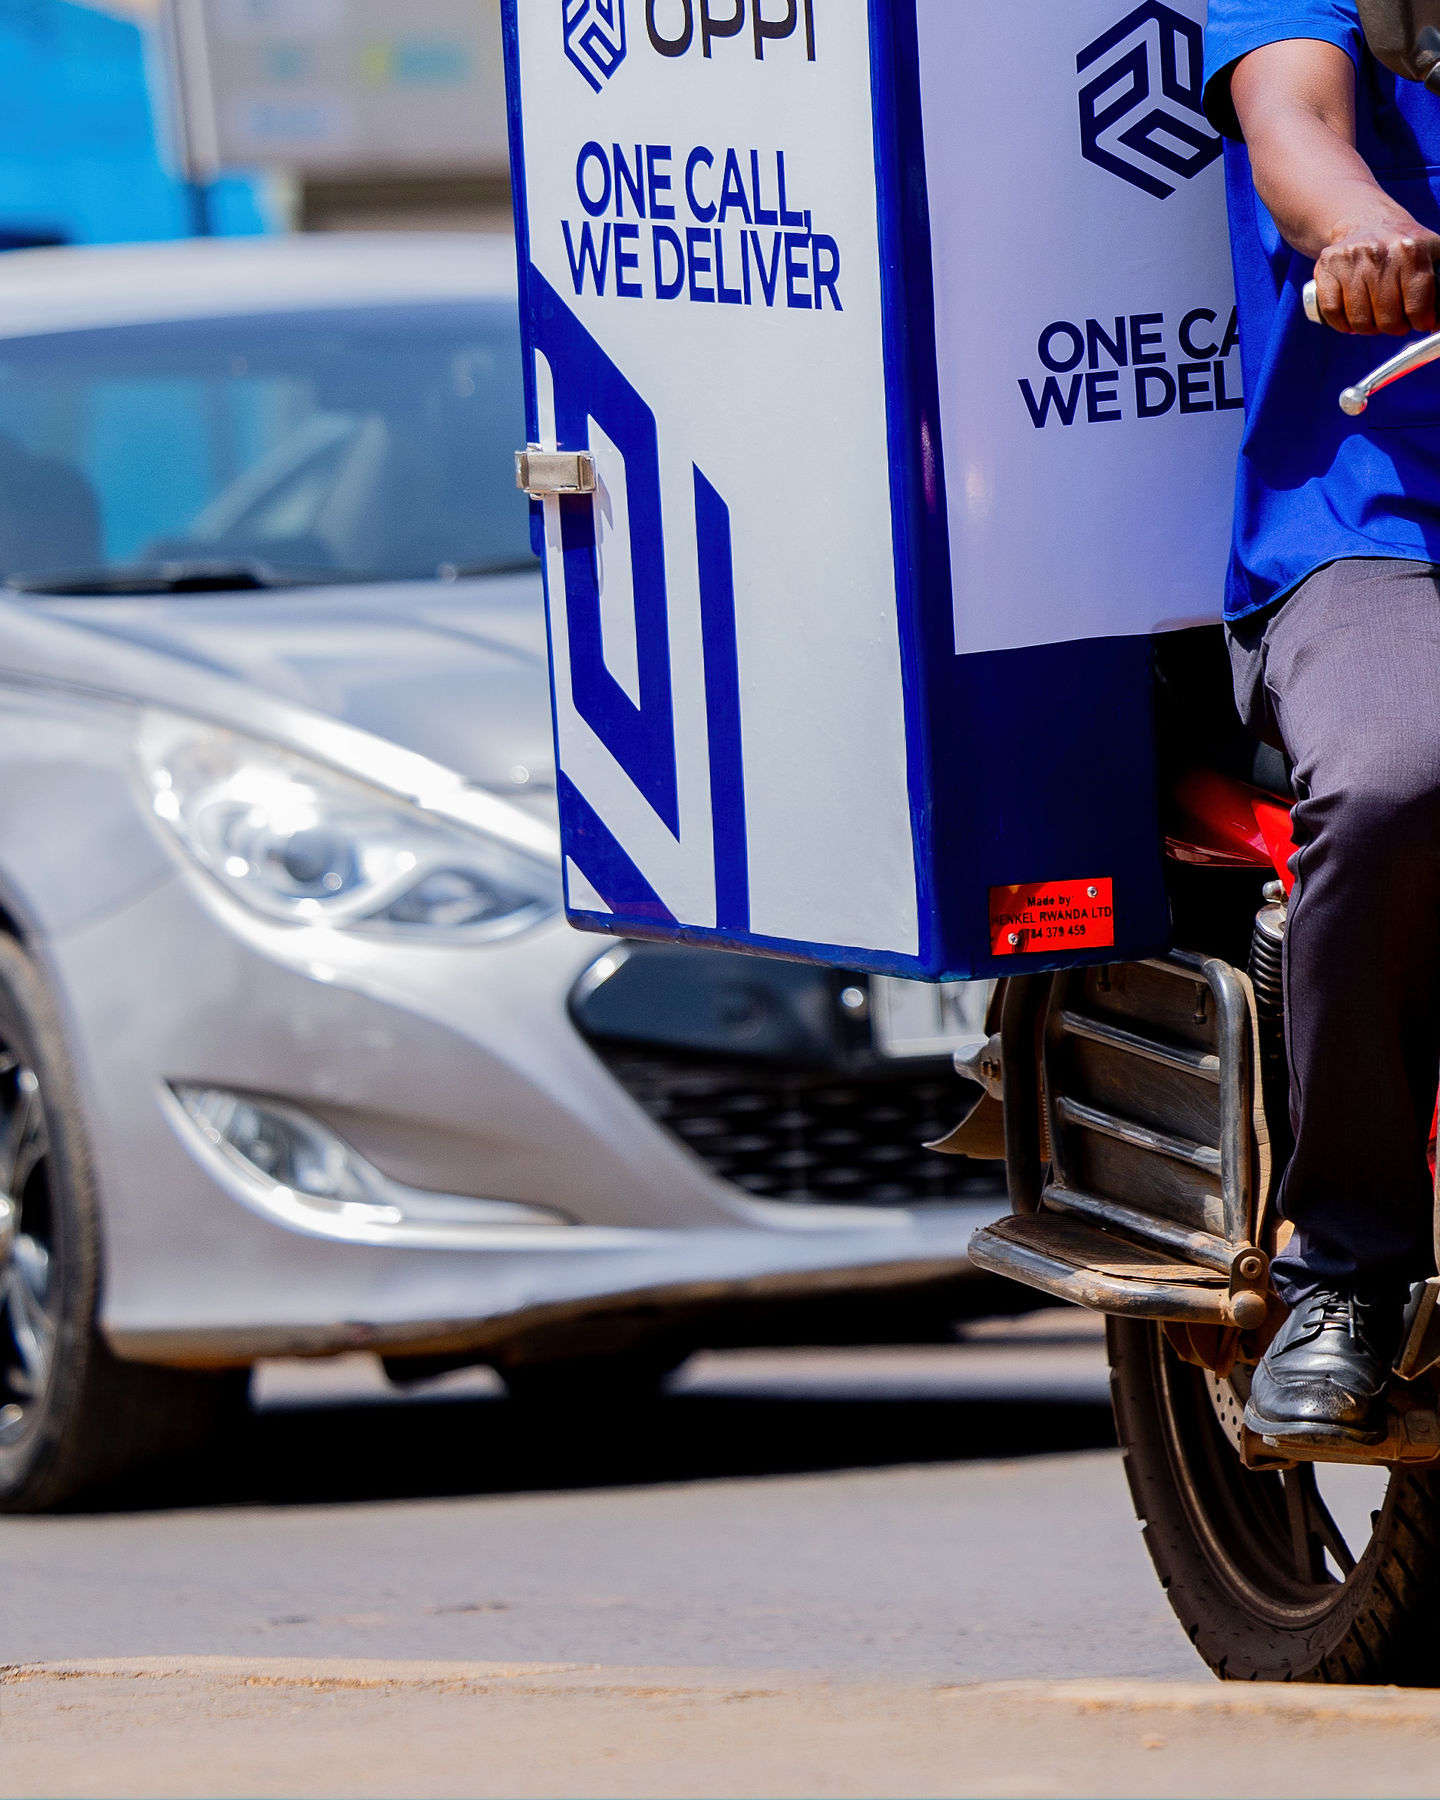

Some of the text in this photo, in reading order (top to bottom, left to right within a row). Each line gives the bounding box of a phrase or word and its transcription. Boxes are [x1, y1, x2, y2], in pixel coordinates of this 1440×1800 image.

[576, 141, 675, 220] ONE
[560, 219, 844, 312] WE DELIVER
[1037, 312, 1166, 373] ONE
[1017, 360, 1244, 428] WE DEL
[1027, 896, 1055, 907] Made
[1039, 908, 1089, 922] RWANDA
[1092, 906, 1112, 919] LTD
[1046, 926, 1065, 938] 379
[1068, 924, 1086, 936] 459
